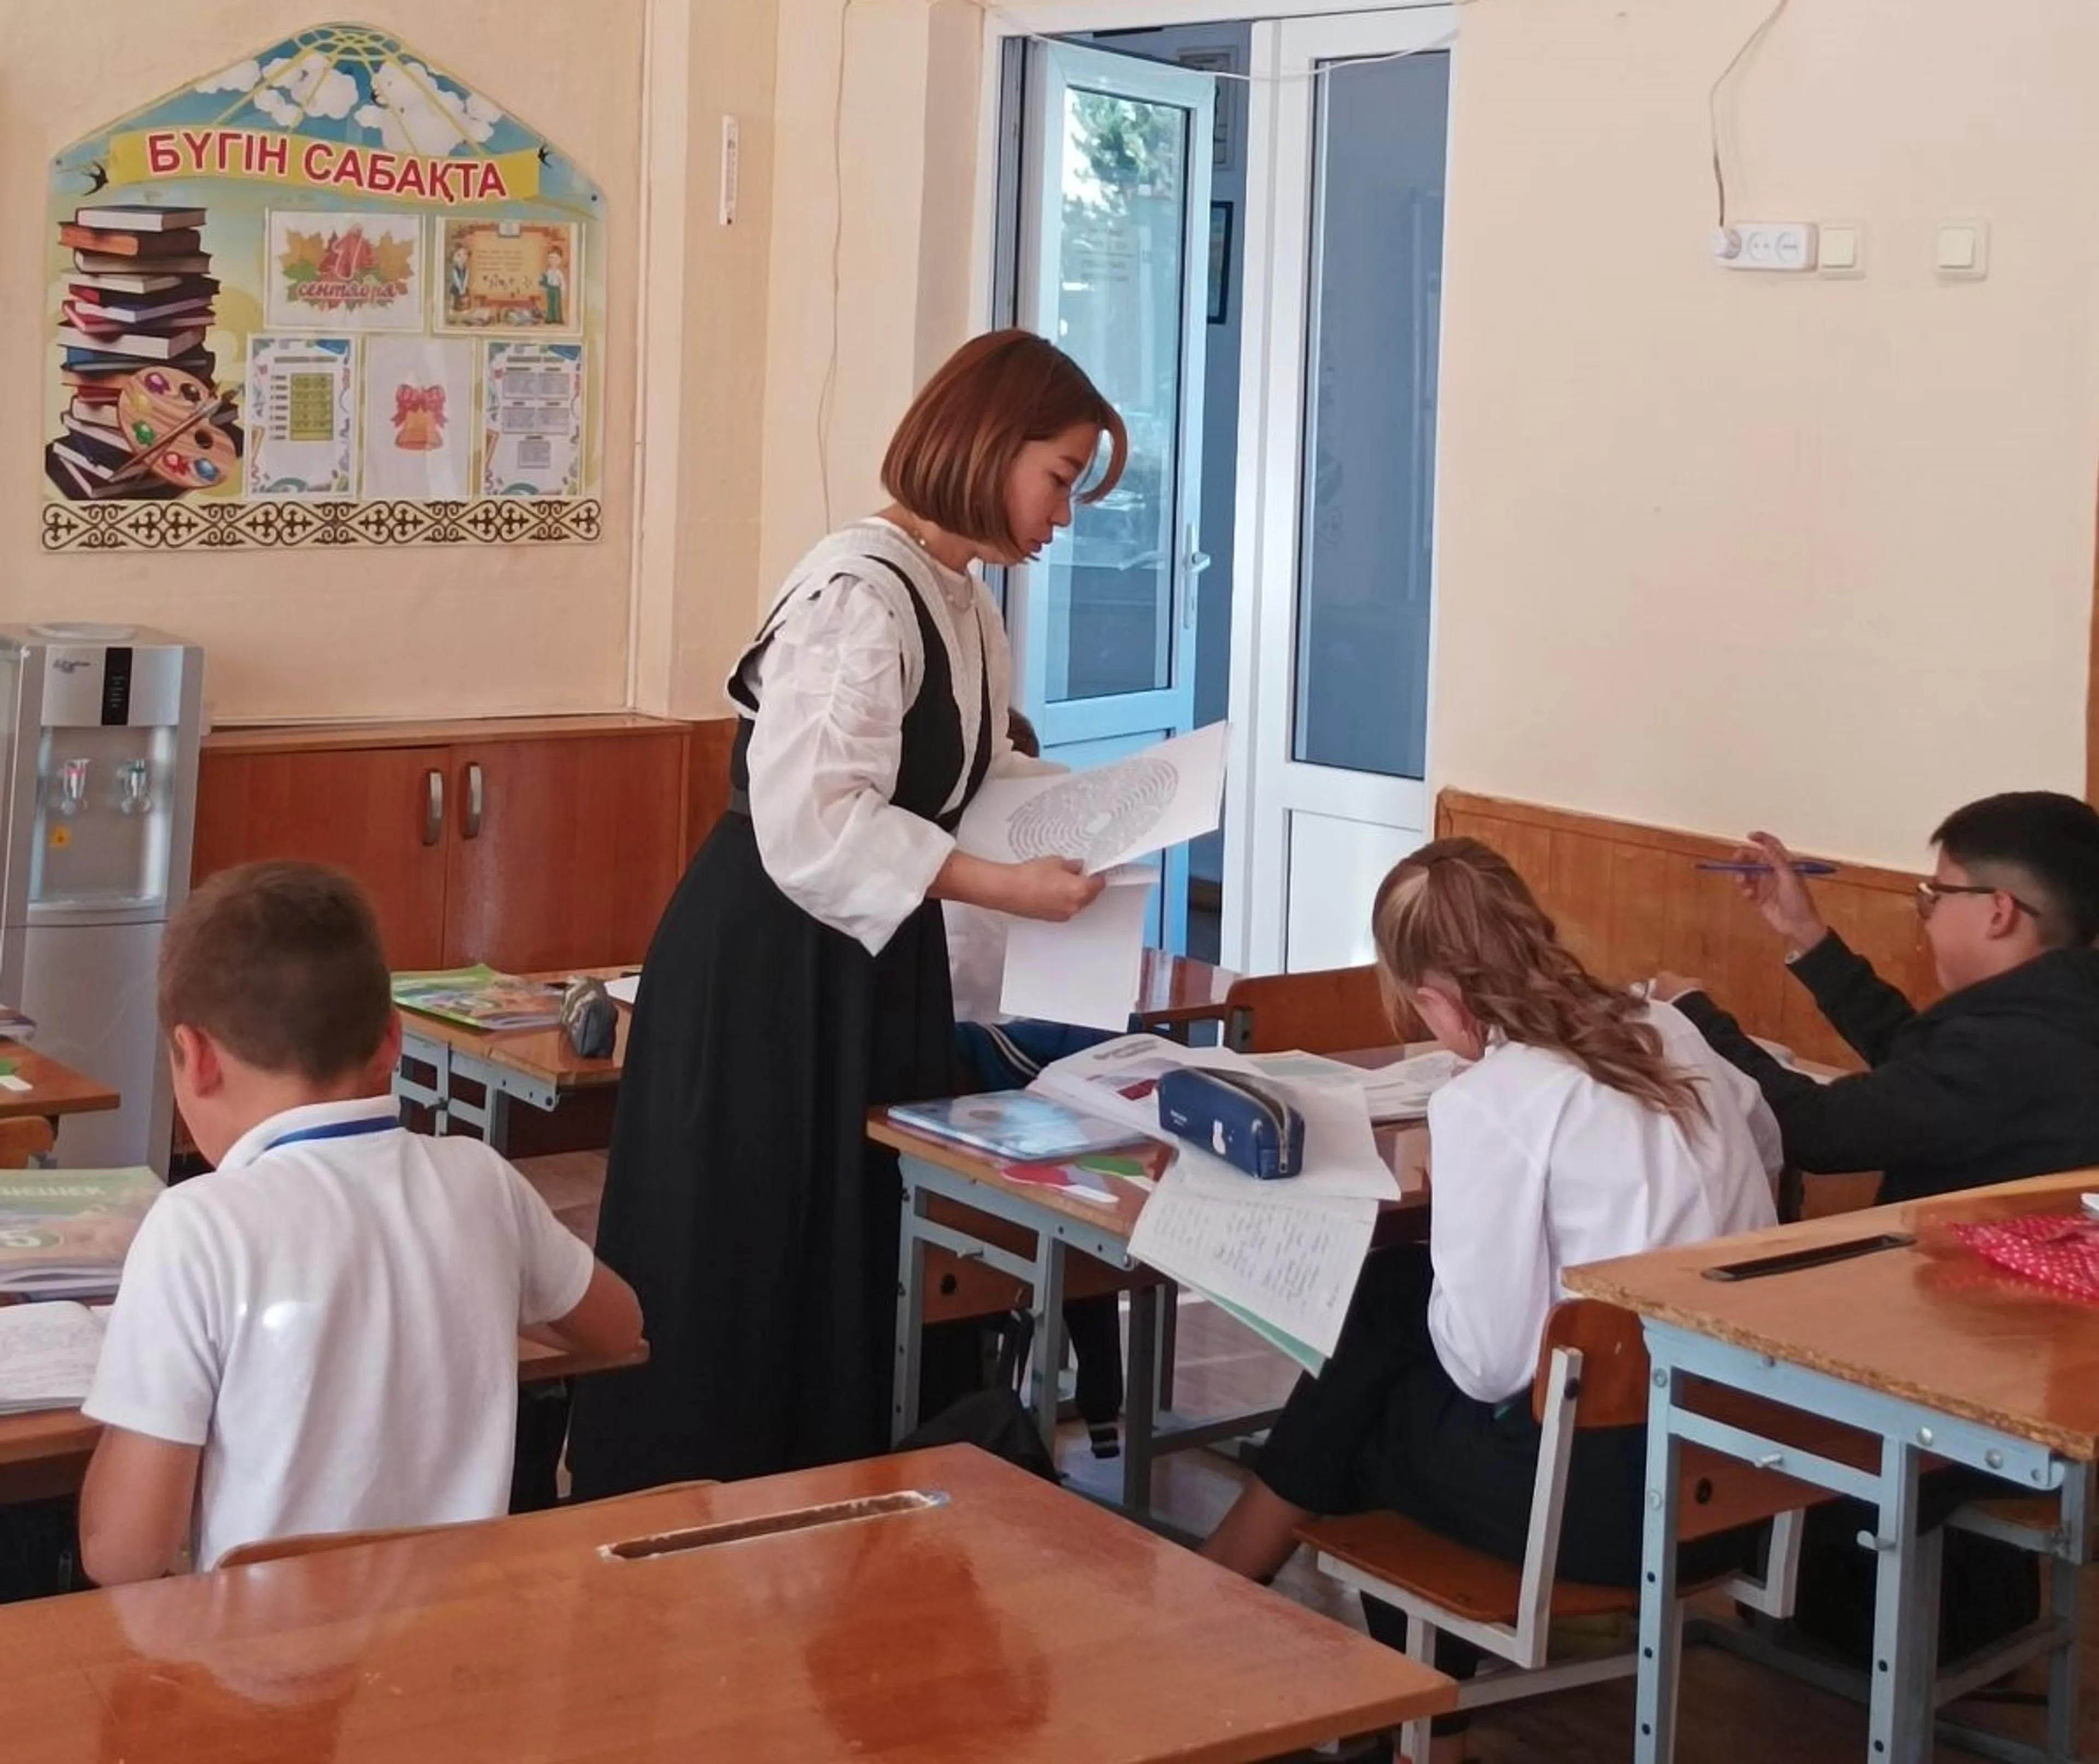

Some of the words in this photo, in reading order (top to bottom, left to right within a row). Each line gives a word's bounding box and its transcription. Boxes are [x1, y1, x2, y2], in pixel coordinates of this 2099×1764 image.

[148, 132, 288, 174] БҮГІН
[303, 143, 507, 203] САБАҚТА
[332, 224, 363, 279] 1
